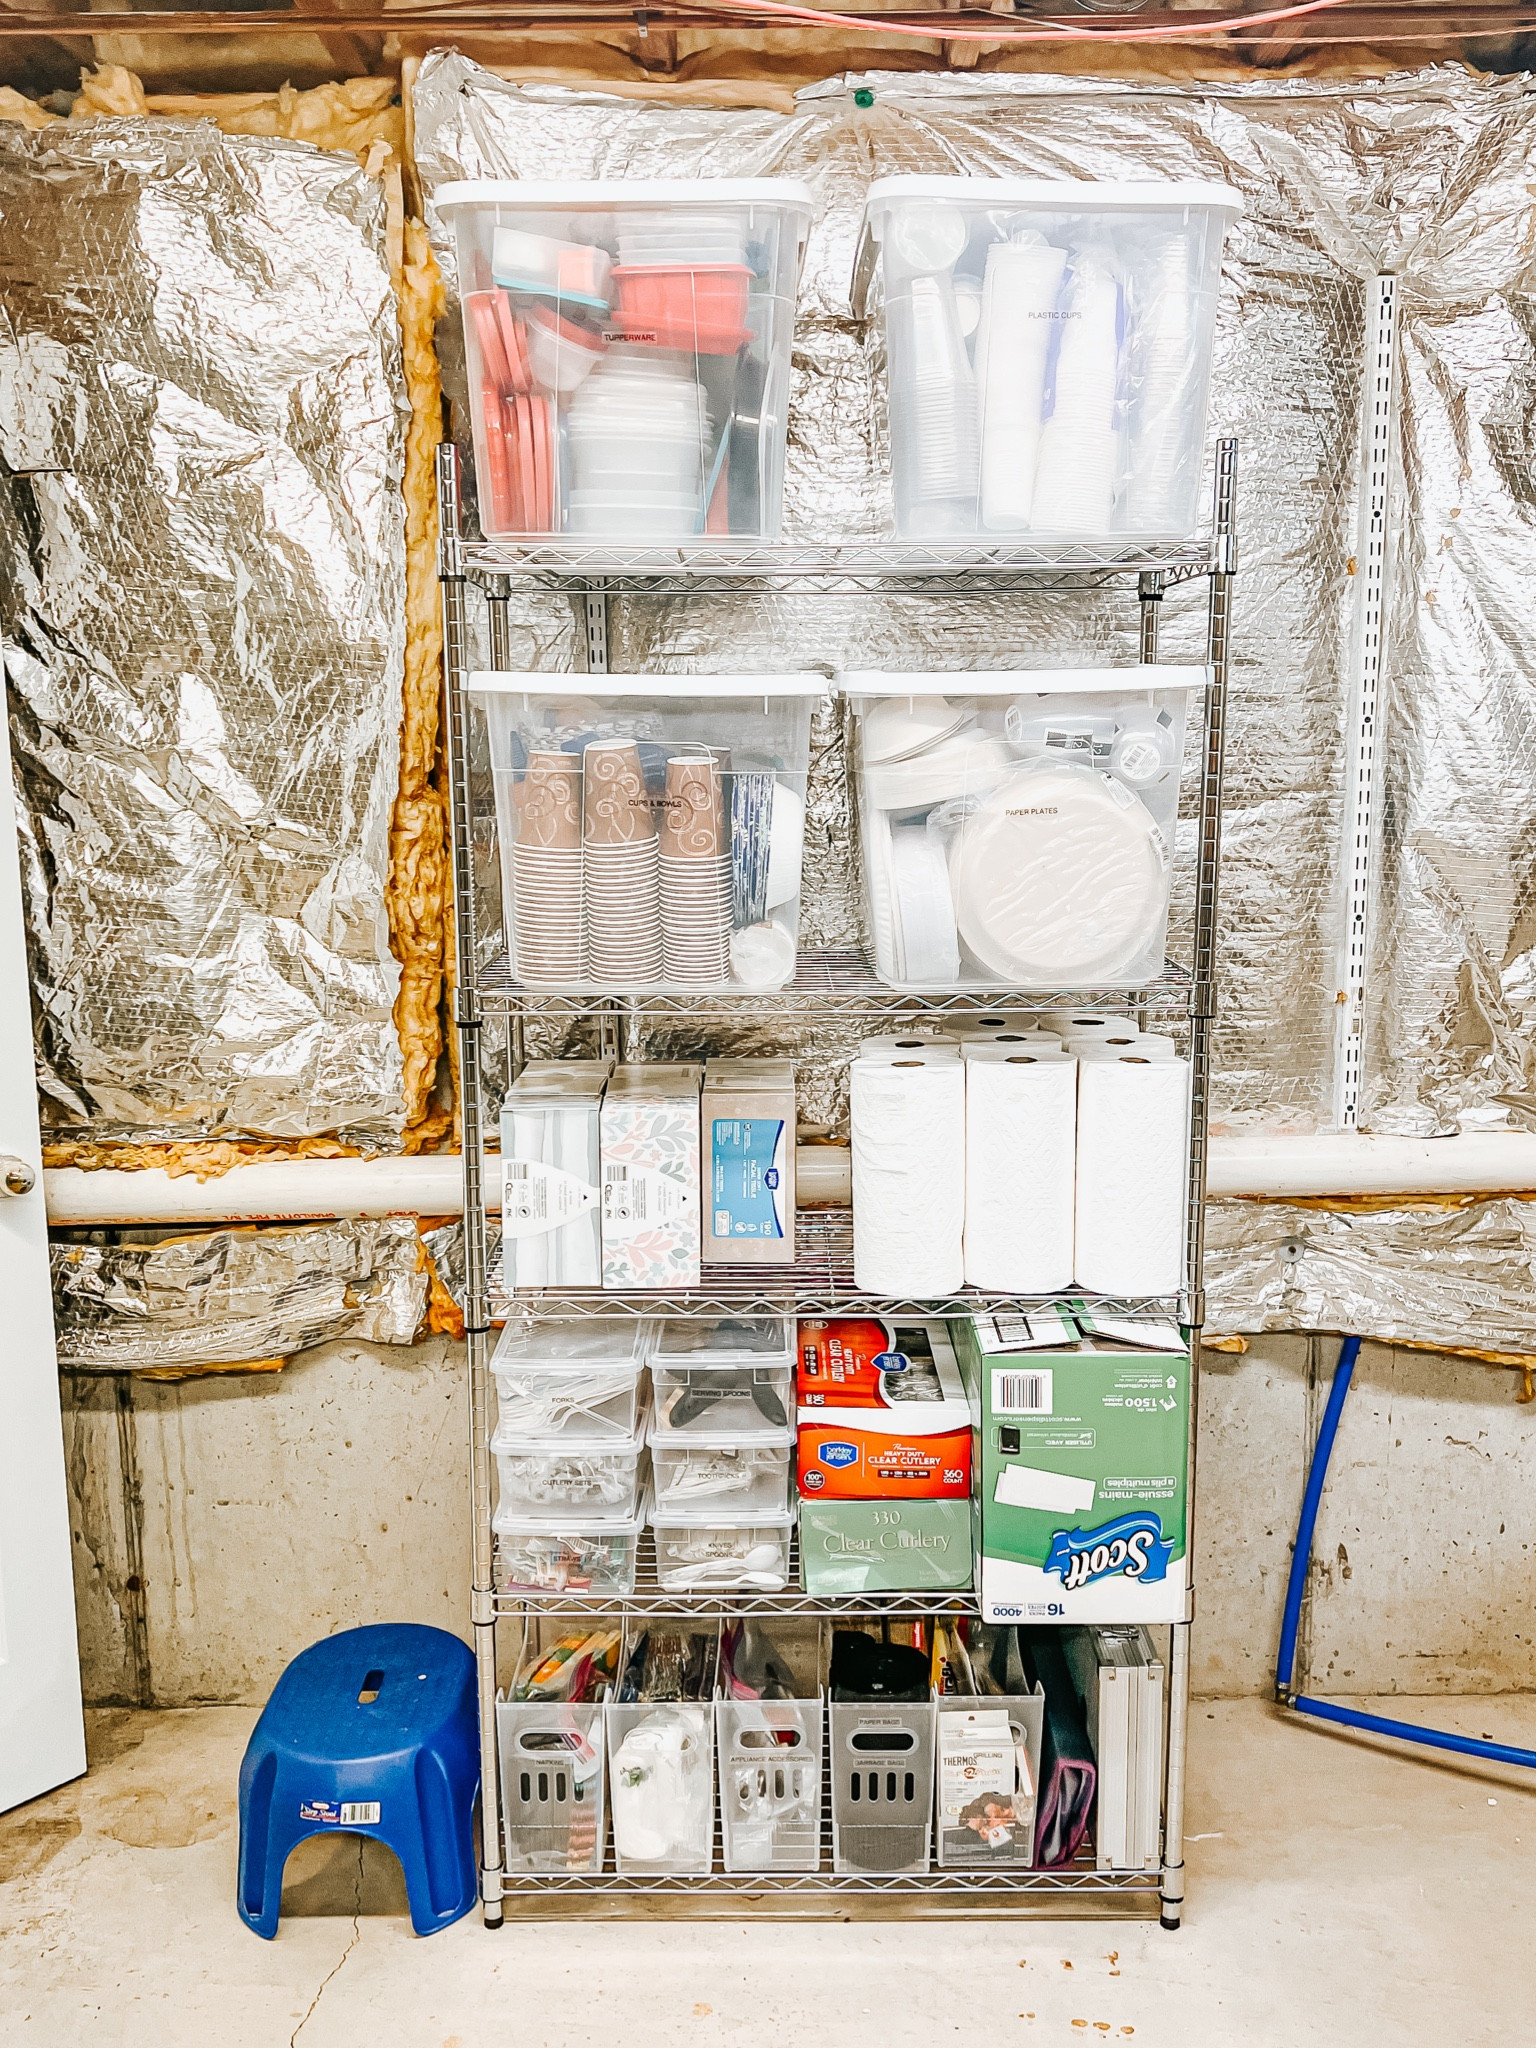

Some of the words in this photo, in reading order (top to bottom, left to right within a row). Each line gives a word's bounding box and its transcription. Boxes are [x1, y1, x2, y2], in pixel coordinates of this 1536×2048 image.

[1028, 311, 1060, 319] PLASTIC
[1061, 311, 1082, 319] CUPS
[604, 333, 657, 341] TUPPERWARE
[628, 799, 649, 807] CUPS
[656, 800, 682, 808] BOWLS
[1005, 808, 1030, 816] PAPER
[1030, 807, 1058, 815] PLATES
[829, 1339, 843, 1357] CLEAR
[1124, 1397, 1158, 1408] 1,500
[867, 1456, 897, 1465] CLEAR
[900, 1456, 942, 1465] CUTLERY
[943, 1469, 963, 1479] 360
[1107, 1478, 1150, 1488] multiples
[1151, 1478, 1167, 1488] plis
[1098, 1490, 1174, 1501] essuie-mains
[872, 1510, 901, 1526] 330
[823, 1532, 874, 1553] Clear
[879, 1528, 952, 1553] Cutlery
[1064, 1529, 1156, 1590] Scott
[992, 1607, 1023, 1617] 4000
[1047, 1603, 1066, 1616] 16
[730, 1755, 766, 1763] APPLIANCE
[767, 1755, 814, 1763] ACCESSORIES
[943, 1756, 978, 1767] THERMOS
